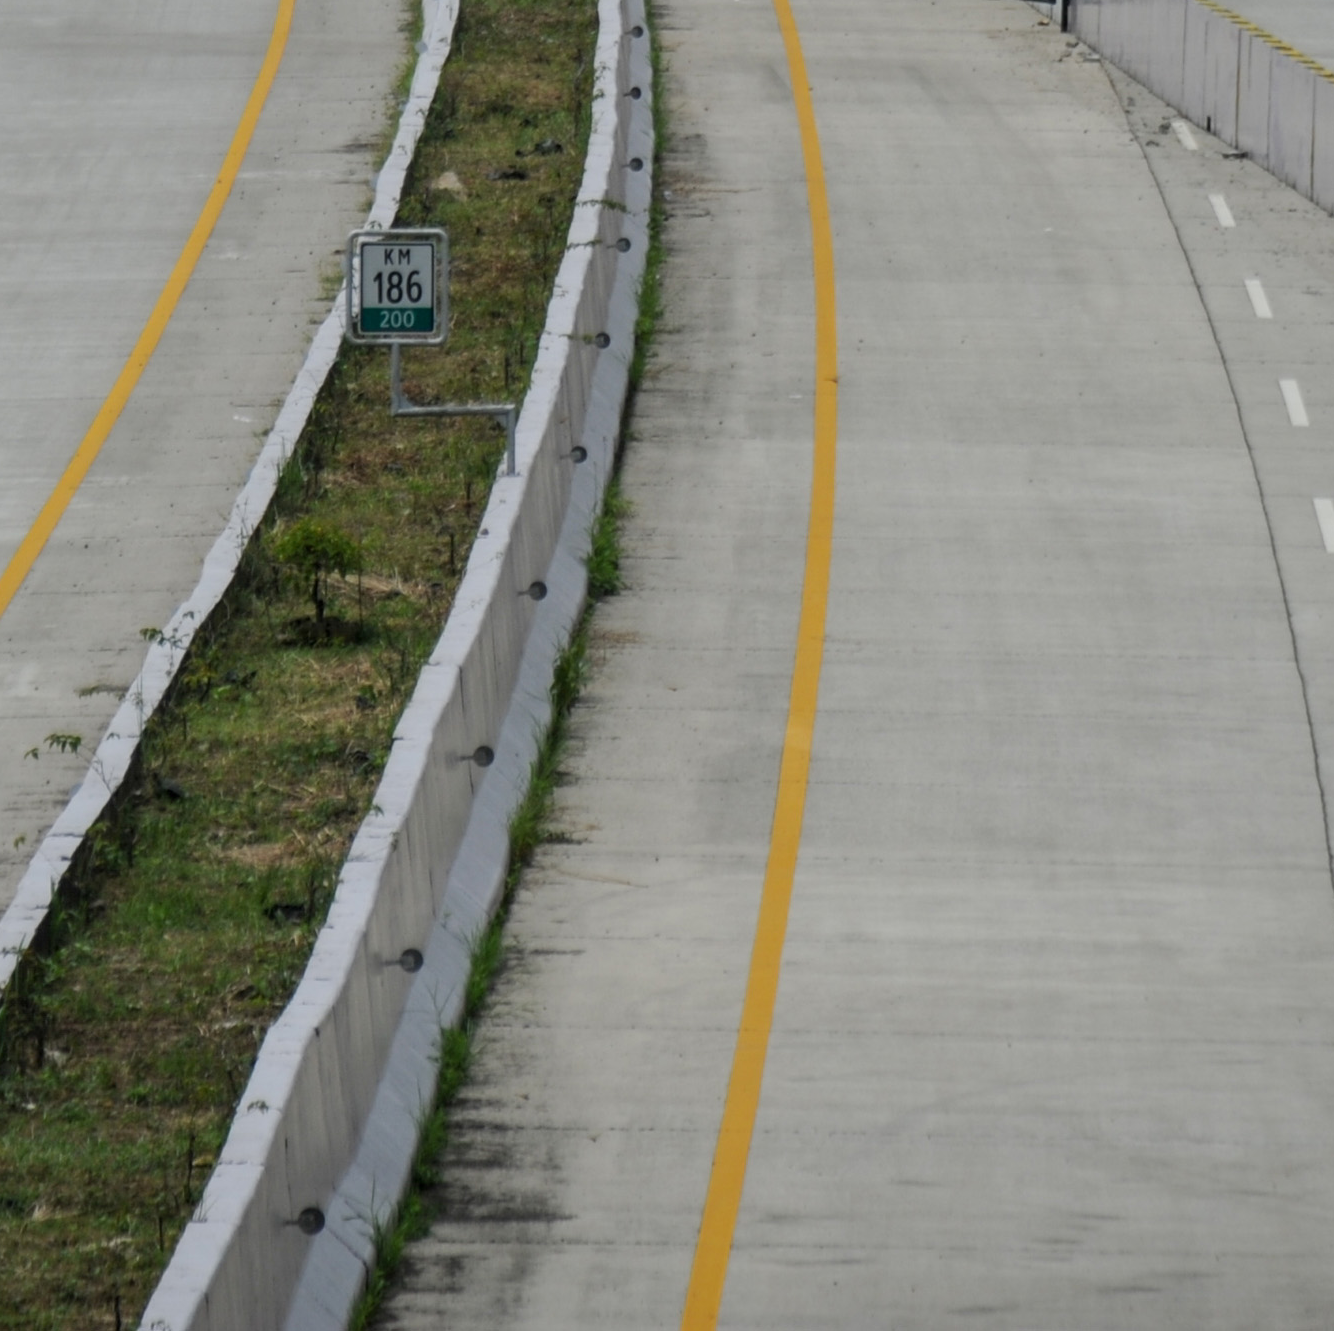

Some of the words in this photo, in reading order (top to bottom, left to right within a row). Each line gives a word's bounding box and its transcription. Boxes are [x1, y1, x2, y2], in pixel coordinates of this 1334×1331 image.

[383, 248, 411, 265] KM
[373, 270, 422, 304] 186
[379, 310, 415, 329] 200
